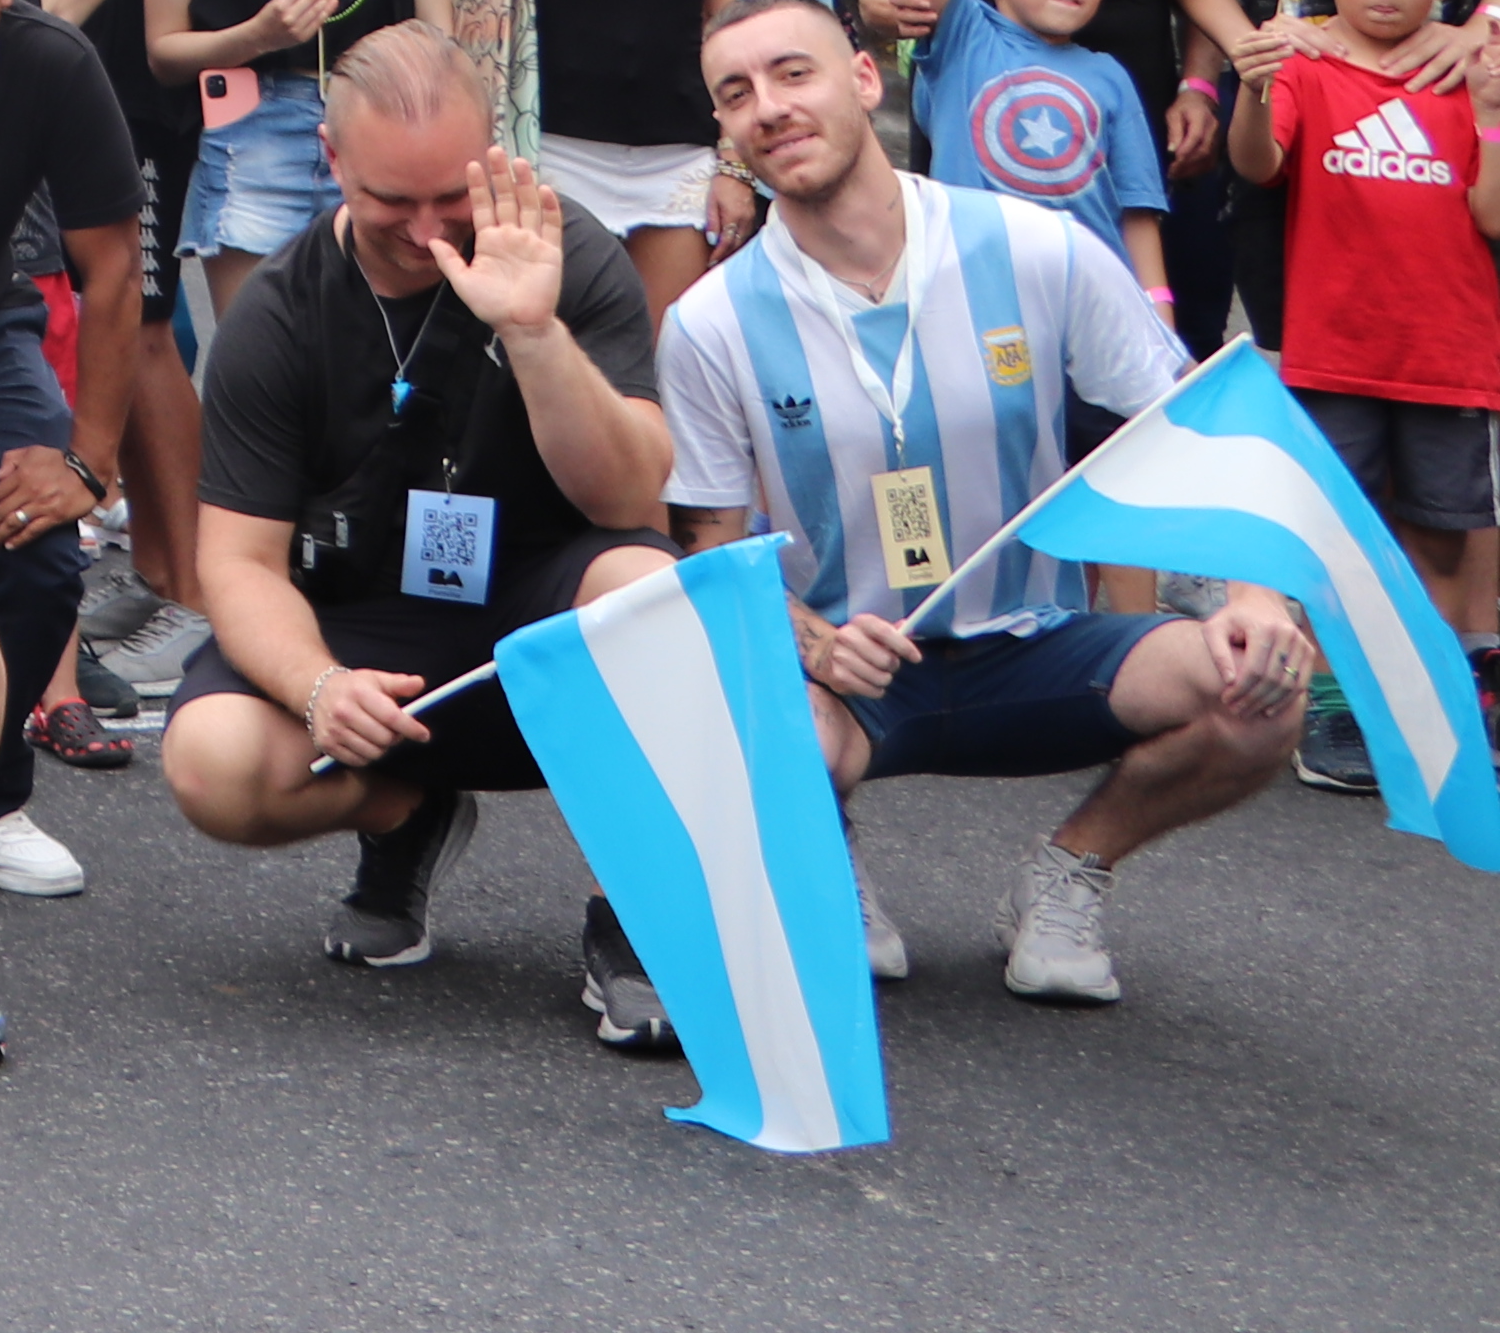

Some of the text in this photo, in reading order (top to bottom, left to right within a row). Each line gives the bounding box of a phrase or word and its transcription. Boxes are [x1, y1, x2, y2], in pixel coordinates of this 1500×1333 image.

[1323, 144, 1451, 186] adidas
[904, 546, 930, 567] BA
[428, 568, 464, 588] BA
